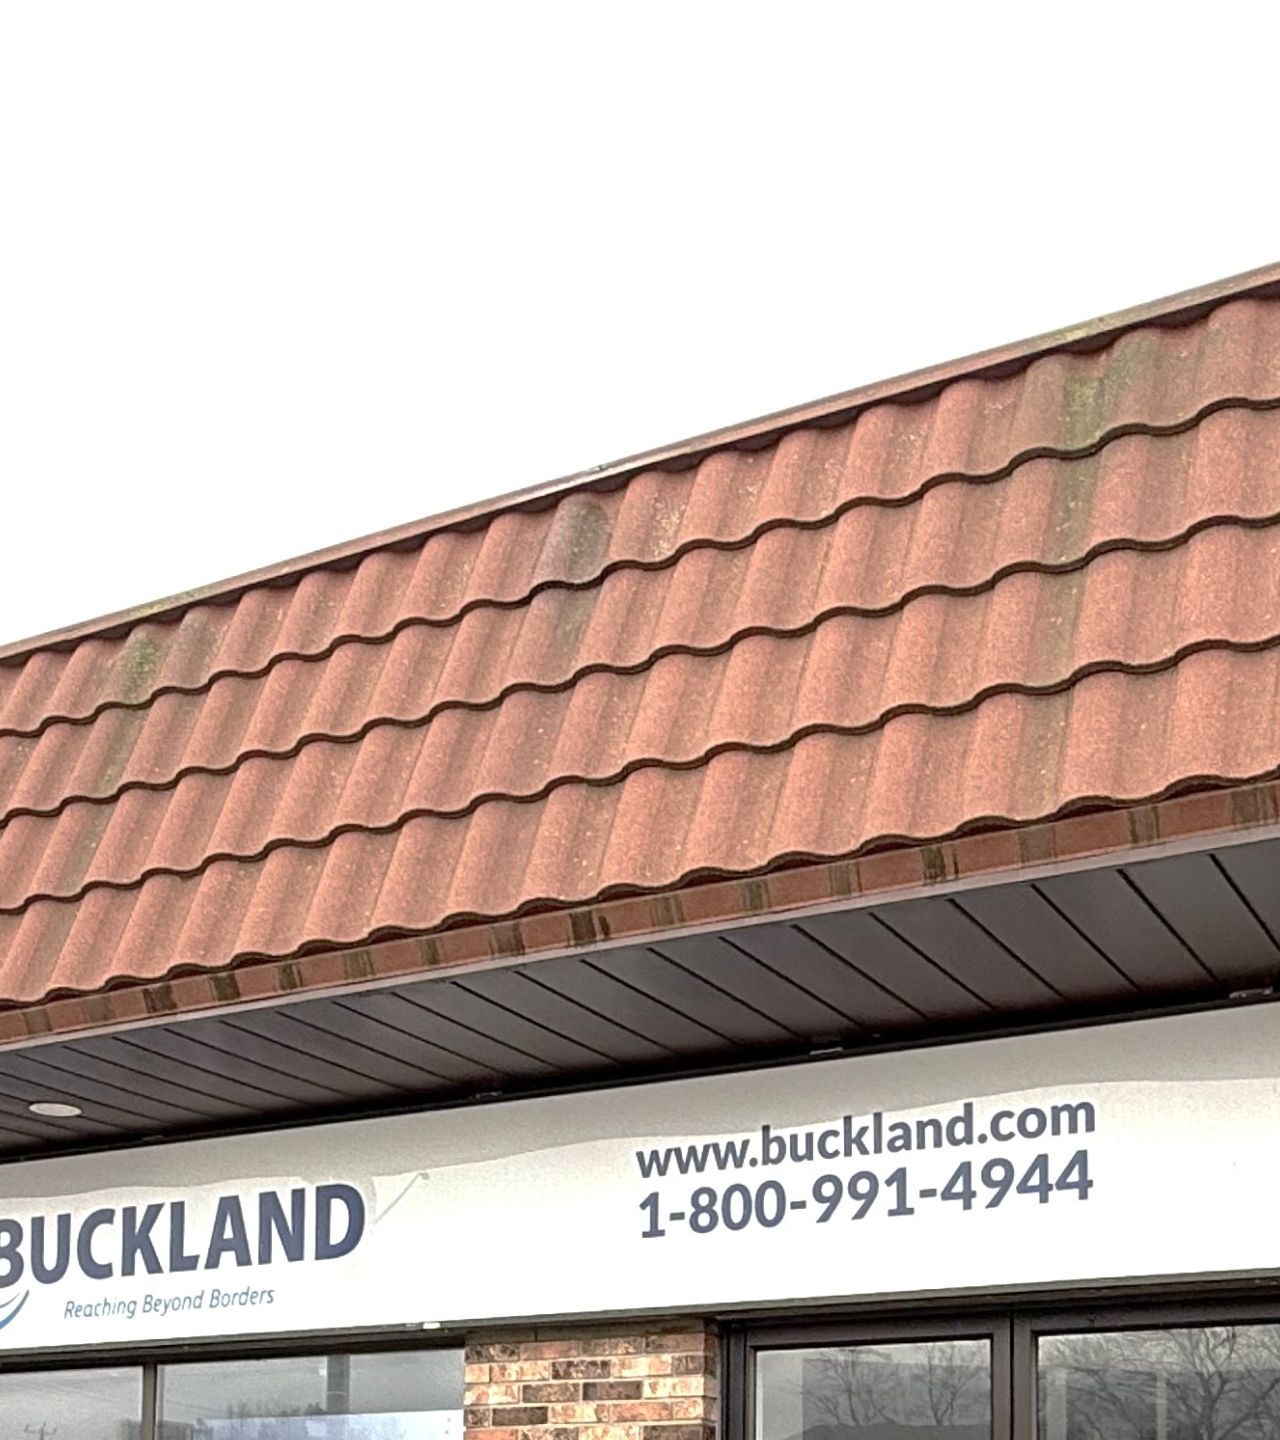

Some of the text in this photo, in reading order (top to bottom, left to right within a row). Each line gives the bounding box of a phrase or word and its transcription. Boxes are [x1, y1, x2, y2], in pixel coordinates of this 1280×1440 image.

[636, 1101, 1096, 1178] www.buckland.com
[639, 1150, 1094, 1238] 1-800-991-4944
[64, 1286, 274, 1320] Reaching Beyond Borders
